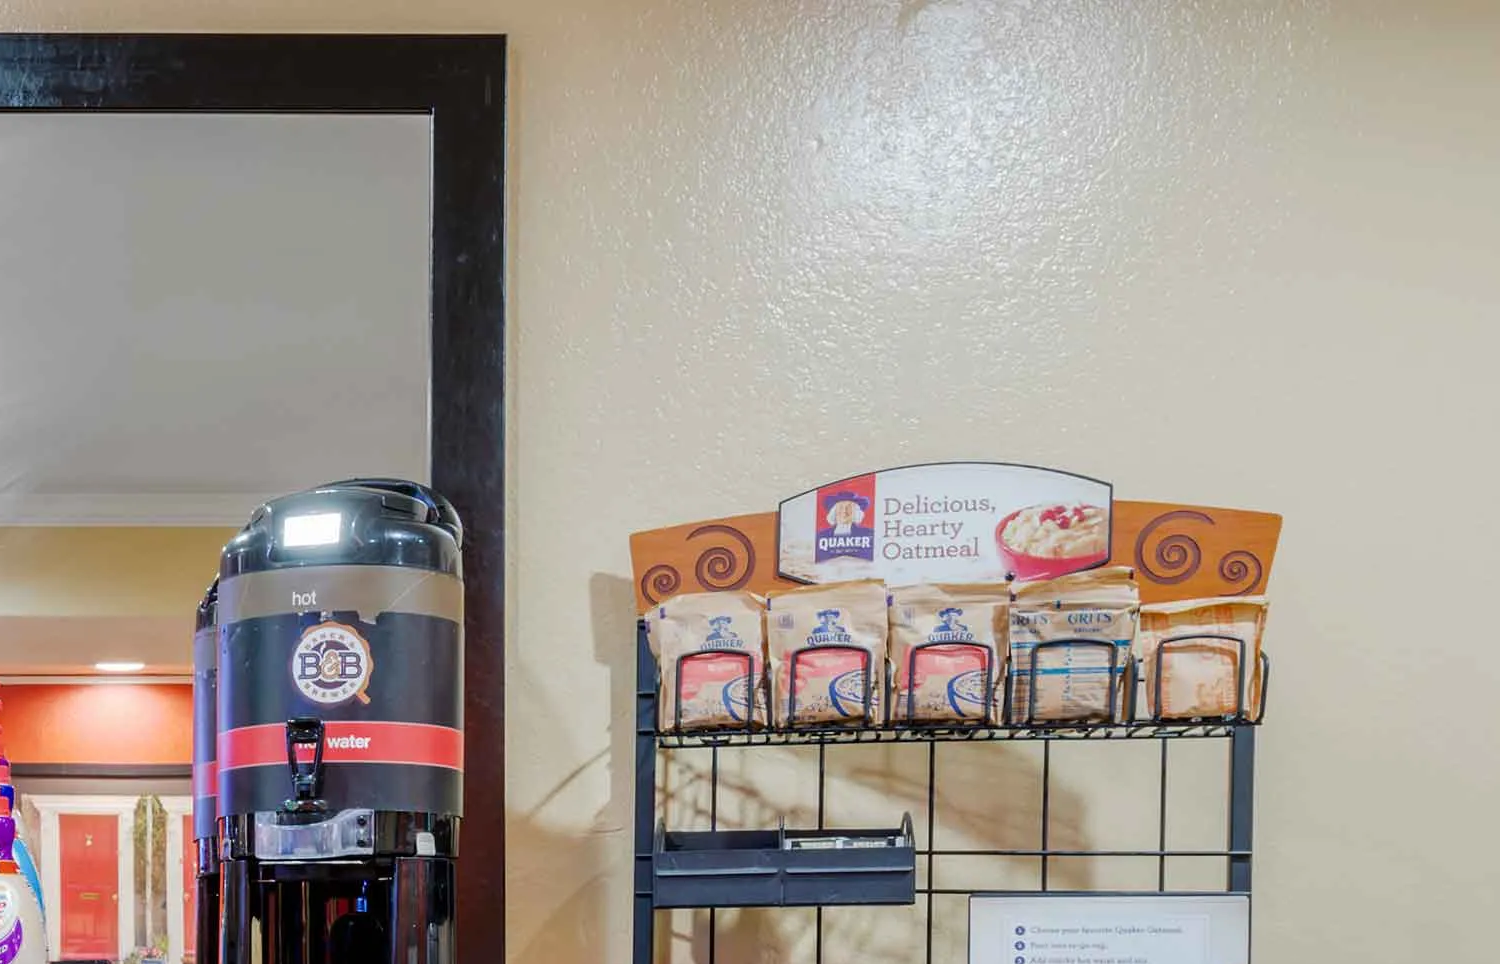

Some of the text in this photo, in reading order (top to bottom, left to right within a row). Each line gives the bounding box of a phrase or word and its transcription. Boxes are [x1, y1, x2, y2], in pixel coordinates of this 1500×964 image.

[883, 495, 997, 516] Delicious,
[883, 519, 964, 540] Hearty
[819, 536, 871, 550] QUAKER
[882, 537, 980, 561] Oatmeal
[292, 591, 317, 606] hot
[1066, 611, 1113, 625] GRITS
[298, 649, 362, 680] B&B
[327, 734, 371, 749] water
